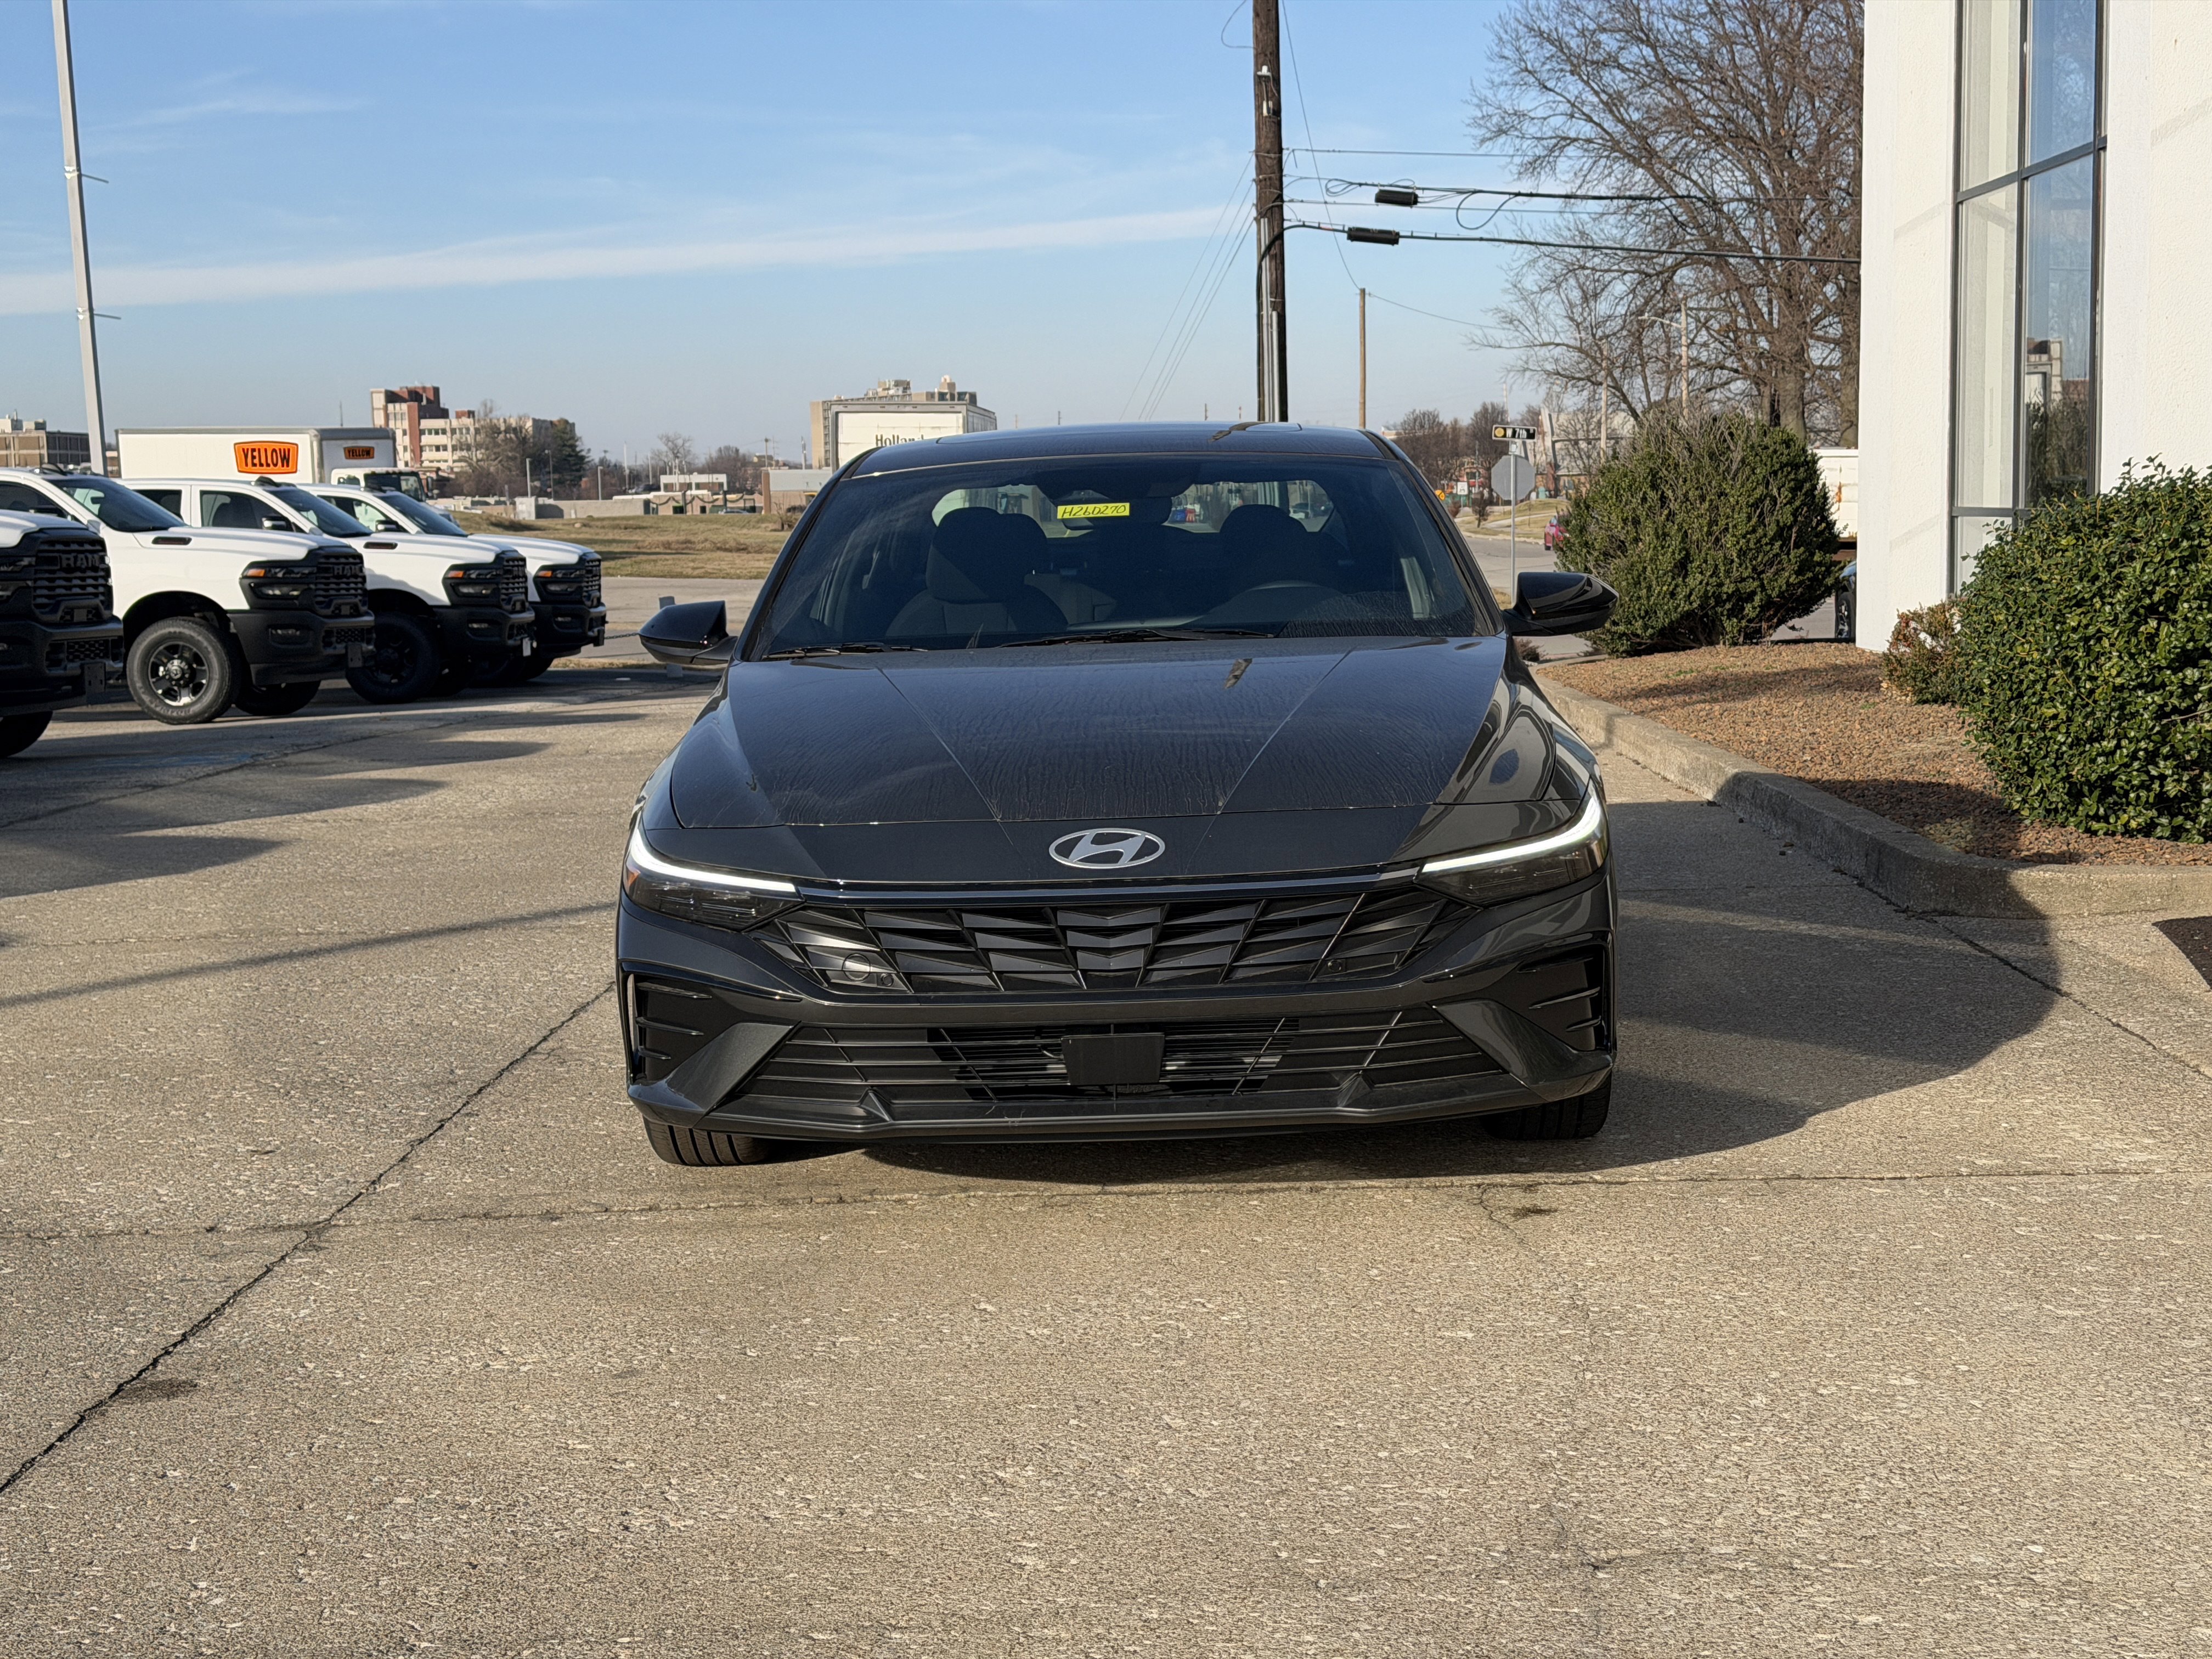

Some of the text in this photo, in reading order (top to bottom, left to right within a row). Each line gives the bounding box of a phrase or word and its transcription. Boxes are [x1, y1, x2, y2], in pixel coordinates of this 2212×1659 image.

[1506, 427, 1513, 438] W
[1515, 428, 1527, 439] 7th
[241, 448, 291, 468] YELLOW
[347, 447, 371, 458] YELLOW
[61, 554, 99, 569] RAM
